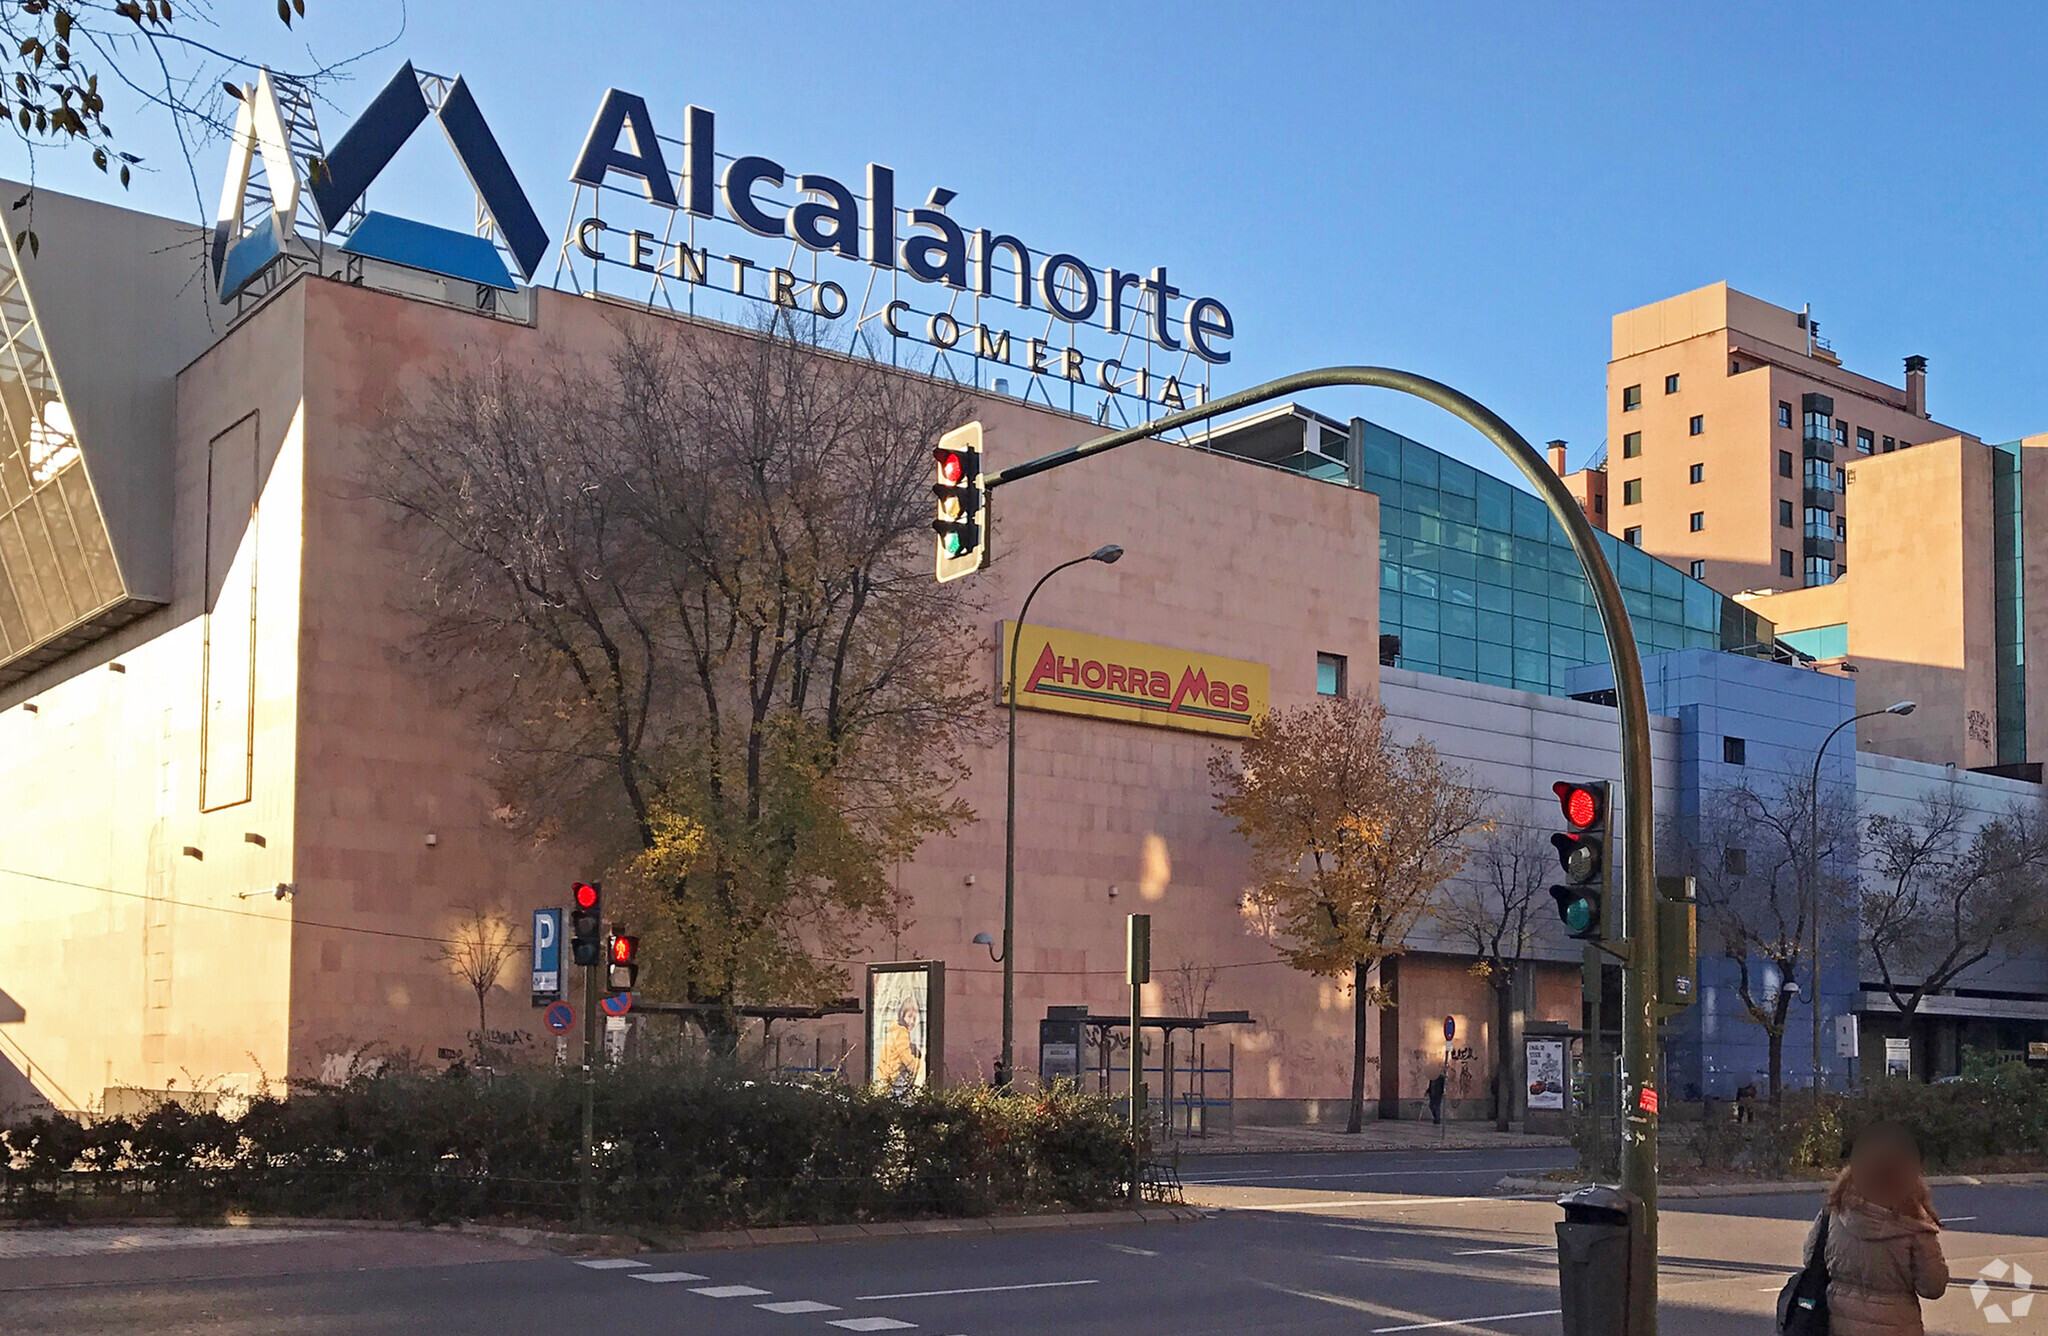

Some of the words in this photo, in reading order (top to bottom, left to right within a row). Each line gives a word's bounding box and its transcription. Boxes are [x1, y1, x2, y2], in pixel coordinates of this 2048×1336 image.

[569, 87, 1233, 364] Alcalánorte
[574, 217, 848, 320] CENTRO
[534, 913, 555, 970] P
